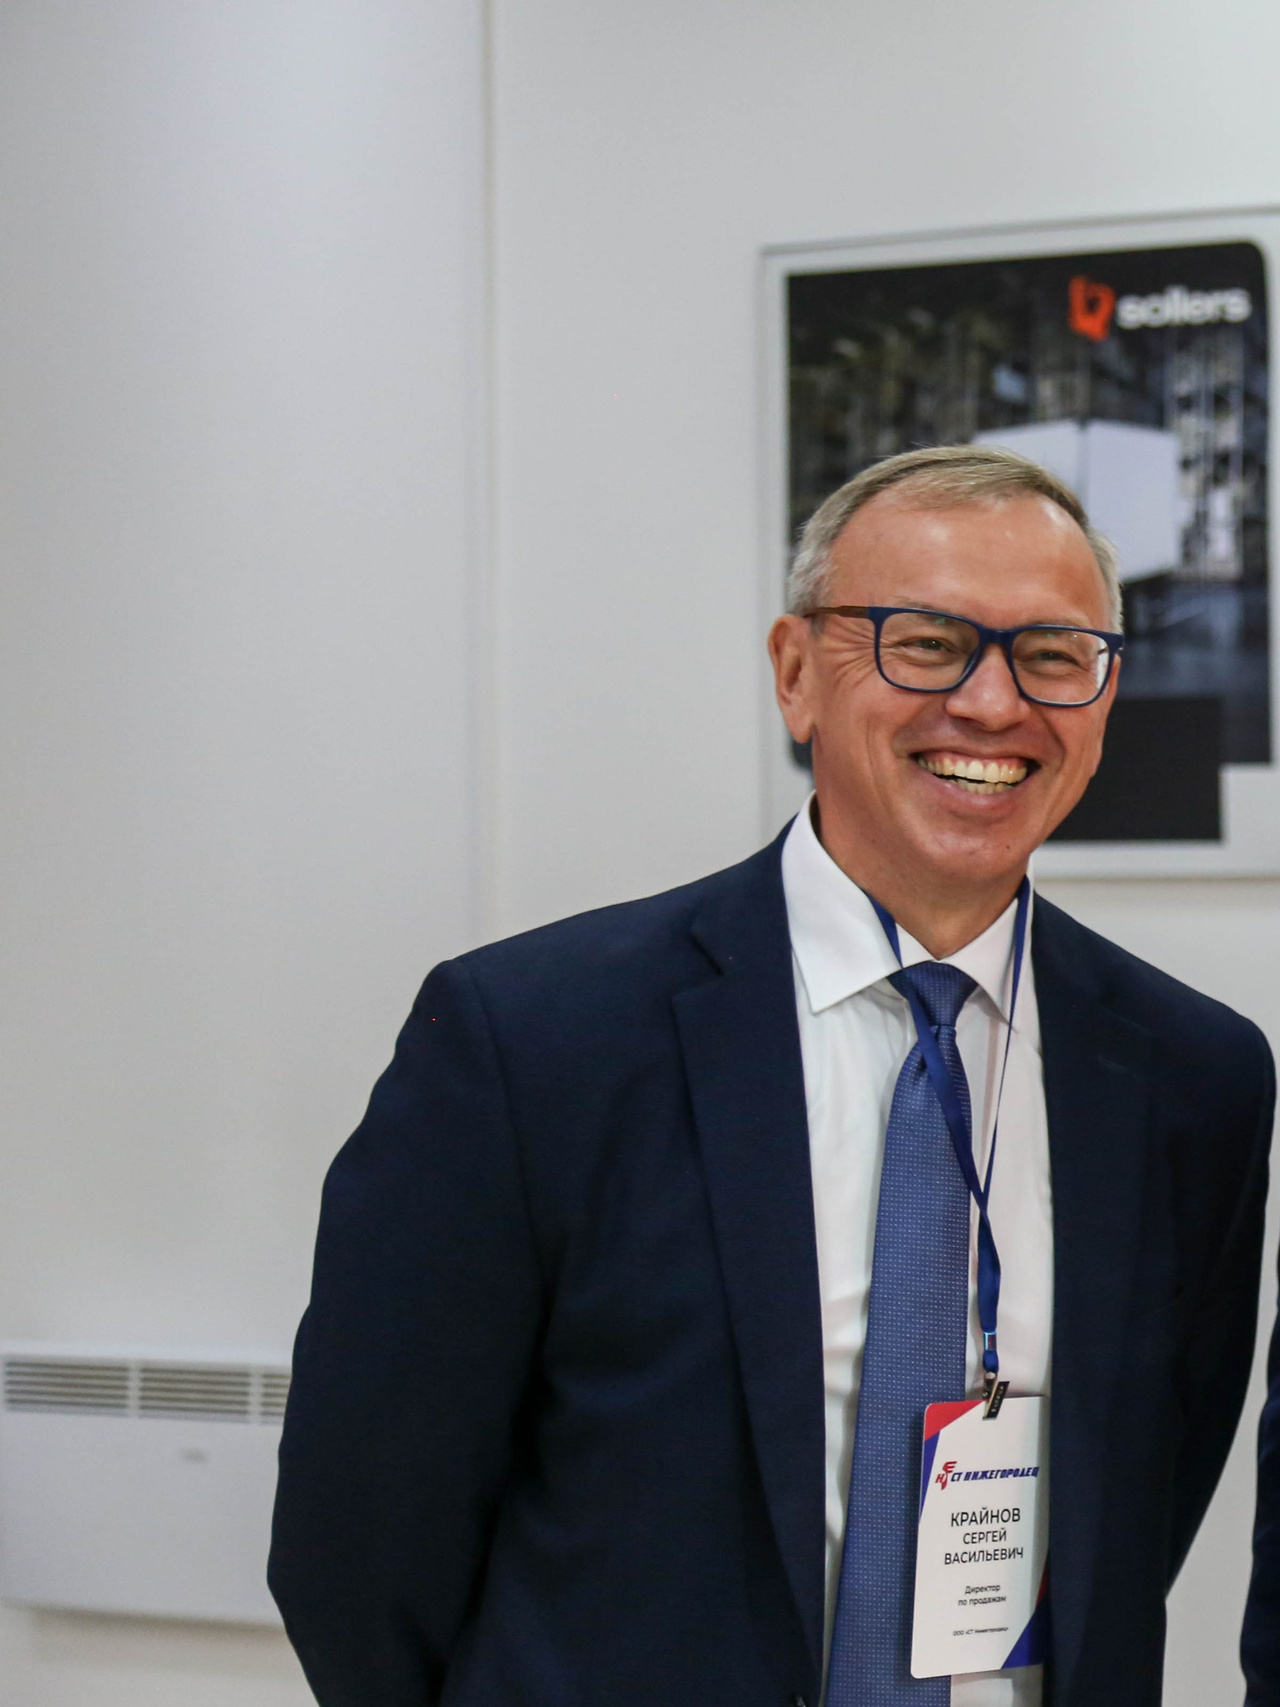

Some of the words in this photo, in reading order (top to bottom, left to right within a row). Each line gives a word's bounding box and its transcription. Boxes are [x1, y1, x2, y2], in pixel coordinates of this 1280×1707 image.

[951, 1472, 963, 1482] СТ
[963, 1467, 1040, 1481] НИЖЕГОРОДЕЦ
[951, 1507, 1021, 1527] КРАЙНОВ
[963, 1528, 1007, 1545] СЕРГЕЙ
[944, 1547, 1024, 1565] ВАСИЛЬЕВИЧ
